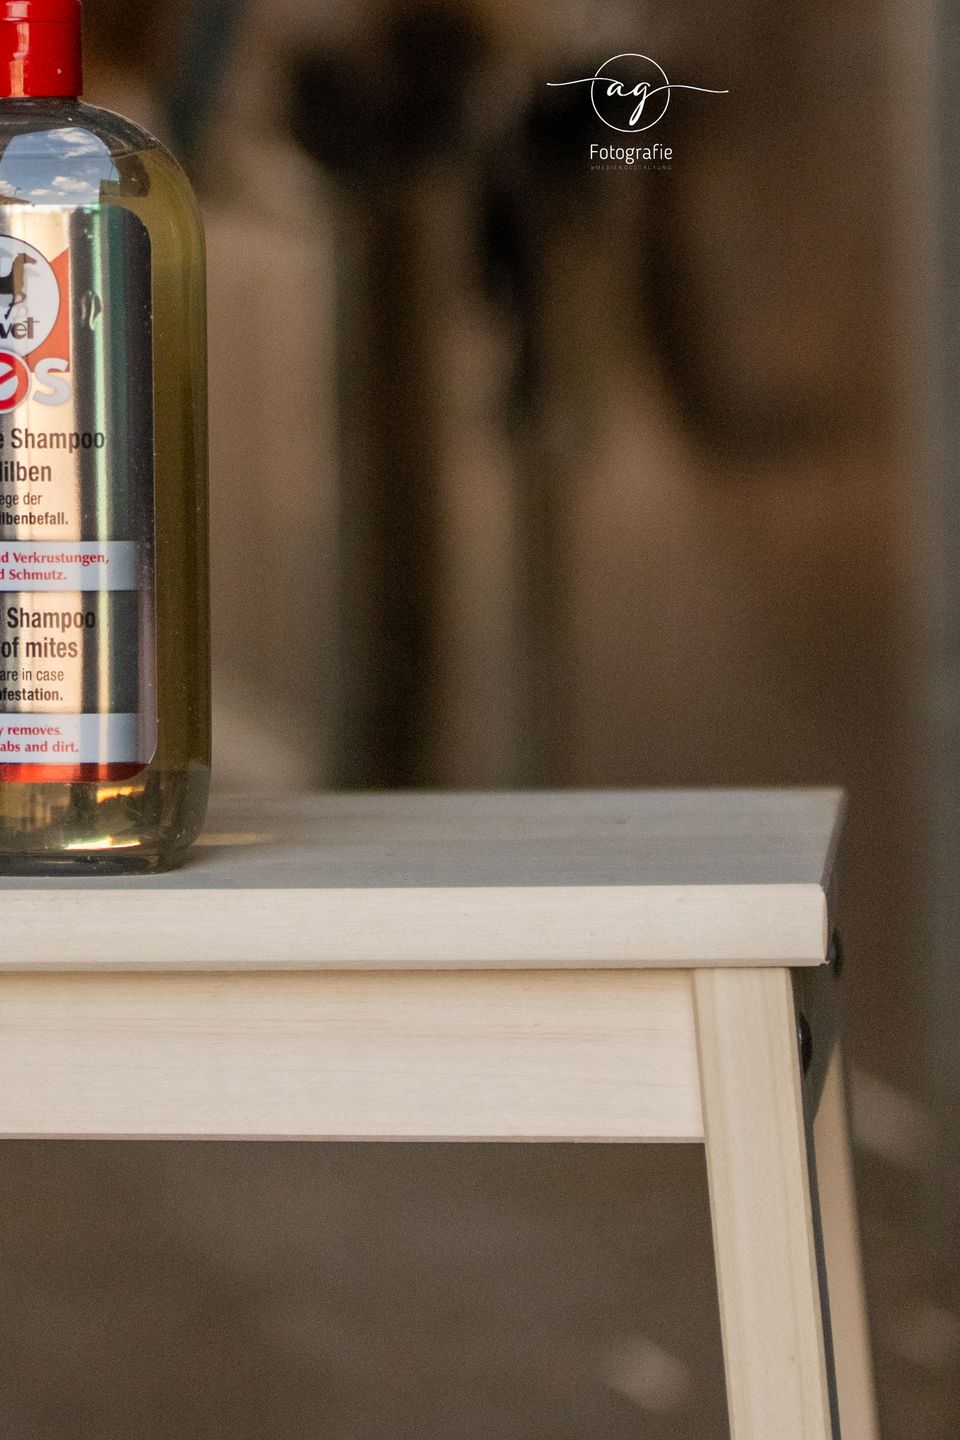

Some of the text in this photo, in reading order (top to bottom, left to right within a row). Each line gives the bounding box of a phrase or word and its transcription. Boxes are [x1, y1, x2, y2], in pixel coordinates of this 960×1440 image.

[11, 428, 105, 450] Shampoo
[23, 492, 42, 505] der
[12, 552, 110, 566] Verkrustungen,
[9, 569, 67, 580] Schmutz.
[7, 608, 96, 632] Shampoo
[2, 638, 19, 658] of
[26, 638, 78, 658] mites
[22, 668, 32, 681] in
[36, 670, 64, 681] case
[24, 741, 49, 753] and
[52, 741, 79, 753] dirt.
